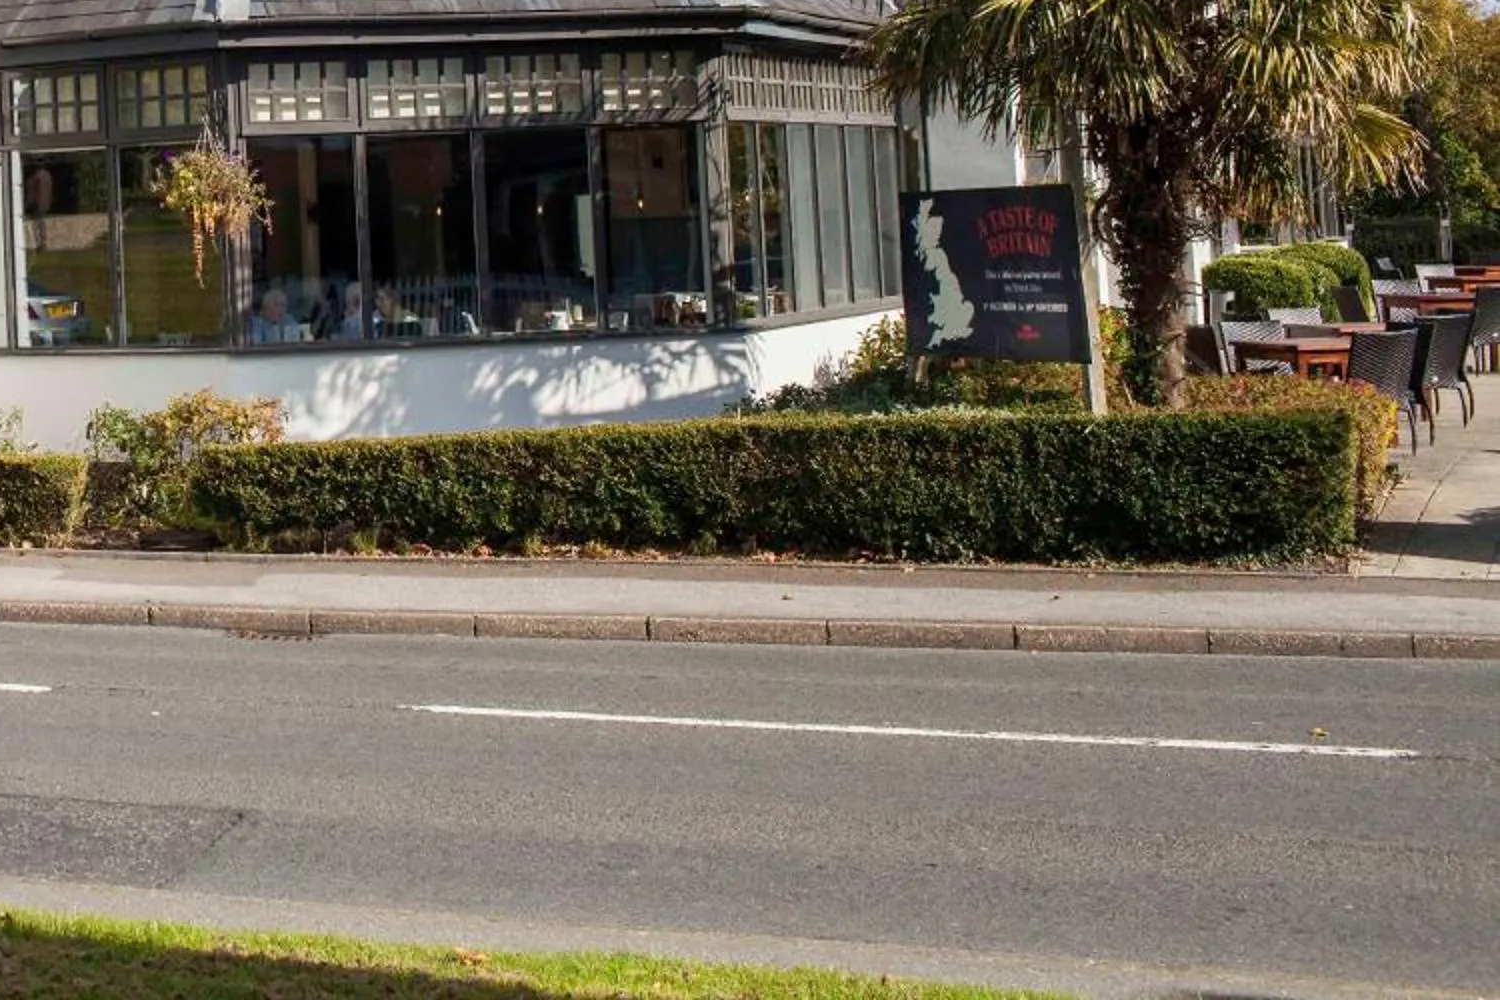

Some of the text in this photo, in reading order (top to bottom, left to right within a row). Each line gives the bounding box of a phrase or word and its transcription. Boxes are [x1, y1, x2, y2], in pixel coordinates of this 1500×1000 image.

[985, 206, 1037, 233] TASTE
[1038, 211, 1060, 236] OF
[986, 232, 1052, 259] BRITAIN
